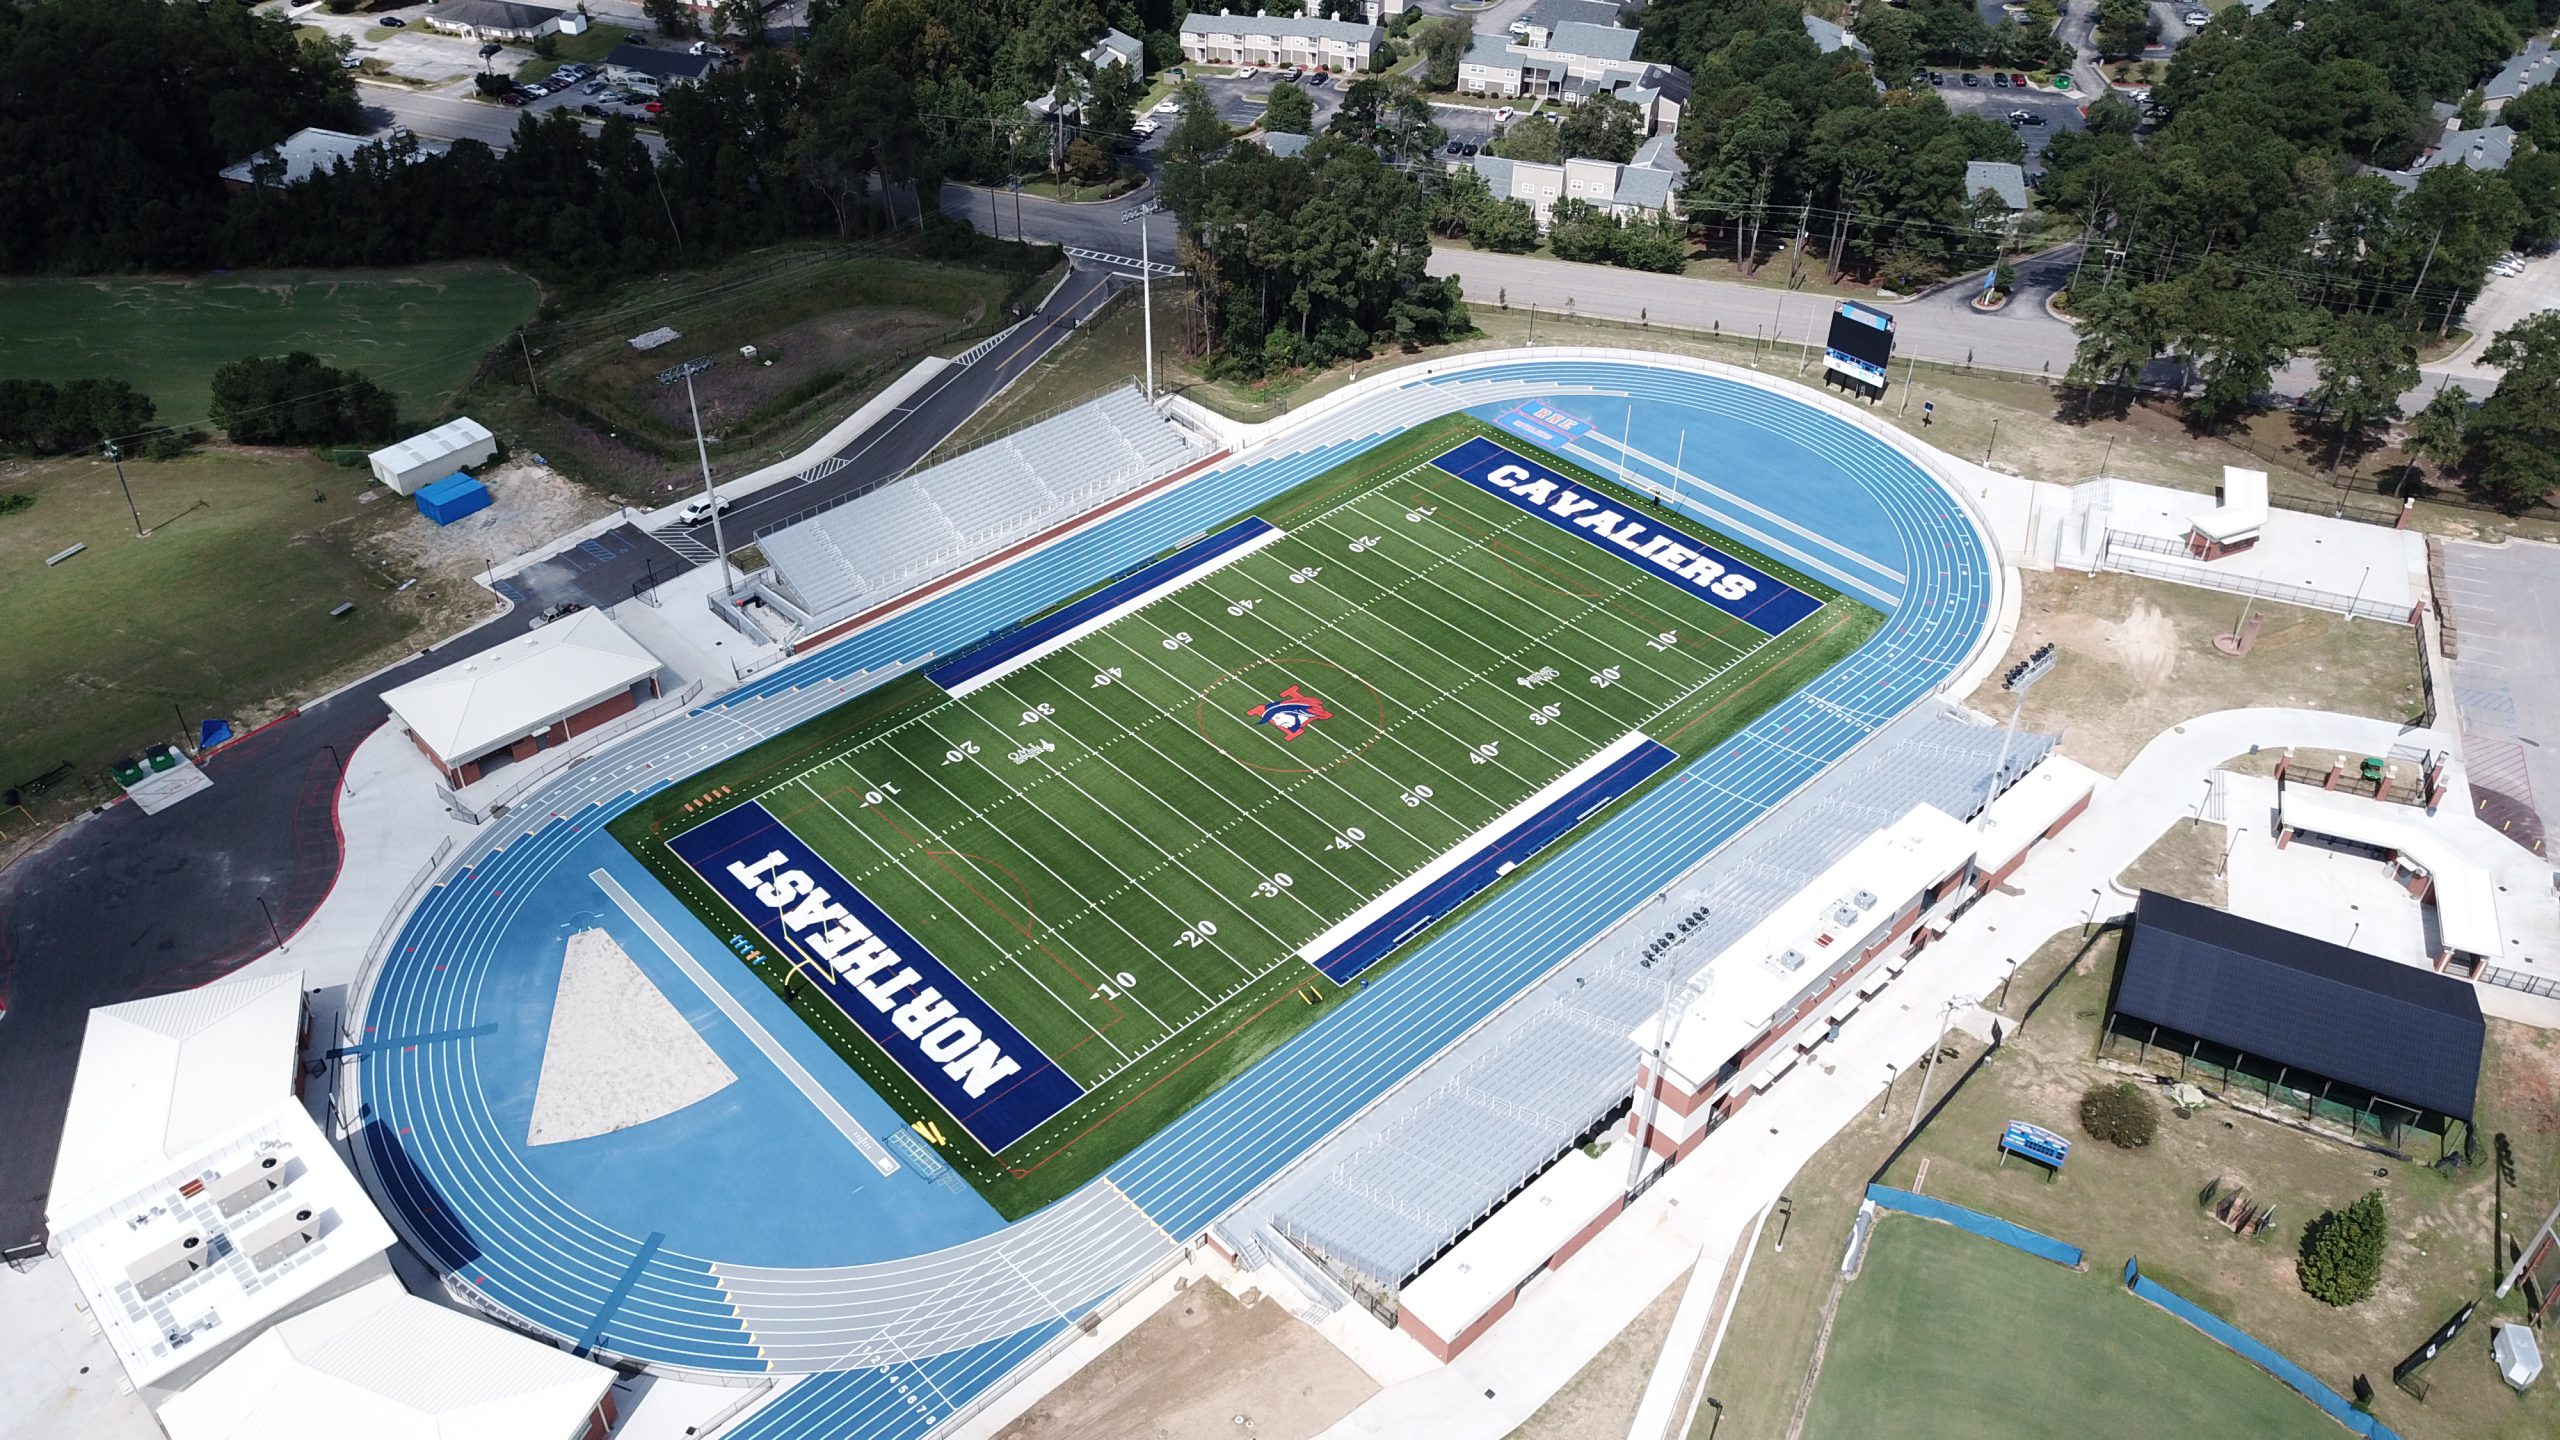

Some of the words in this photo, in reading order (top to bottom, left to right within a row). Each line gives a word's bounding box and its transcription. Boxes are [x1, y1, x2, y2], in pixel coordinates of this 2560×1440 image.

[1533, 407, 1578, 430] RNE
[1405, 506, 1434, 523] 10
[1487, 465, 1757, 601] CAVALIERS
[1349, 535, 1377, 553] 20
[1289, 567, 1319, 584] 30
[1227, 599, 1255, 617] 40
[1162, 632, 1193, 650] 50
[1647, 633, 1678, 652] 10
[1093, 667, 1123, 686] 40
[1589, 669, 1621, 689] 20
[1022, 703, 1055, 723] 30
[1529, 706, 1561, 726] 30
[946, 741, 980, 762] 20
[1469, 745, 1499, 765] 40
[865, 782, 901, 804] 10
[1400, 785, 1434, 807] 50
[1335, 827, 1365, 850] 40
[1258, 872, 1294, 898] 30
[1181, 921, 1217, 948] 20
[726, 849, 1022, 1099] NORTHEAST
[1097, 972, 1136, 1000] 10
[870, 1355, 881, 1364] 2
[880, 1365, 890, 1374] 3
[889, 1375, 899, 1384] 4
[898, 1385, 909, 1394] 5
[907, 1395, 918, 1404] 6
[916, 1405, 927, 1413] 7
[925, 1415, 936, 1425] 8
